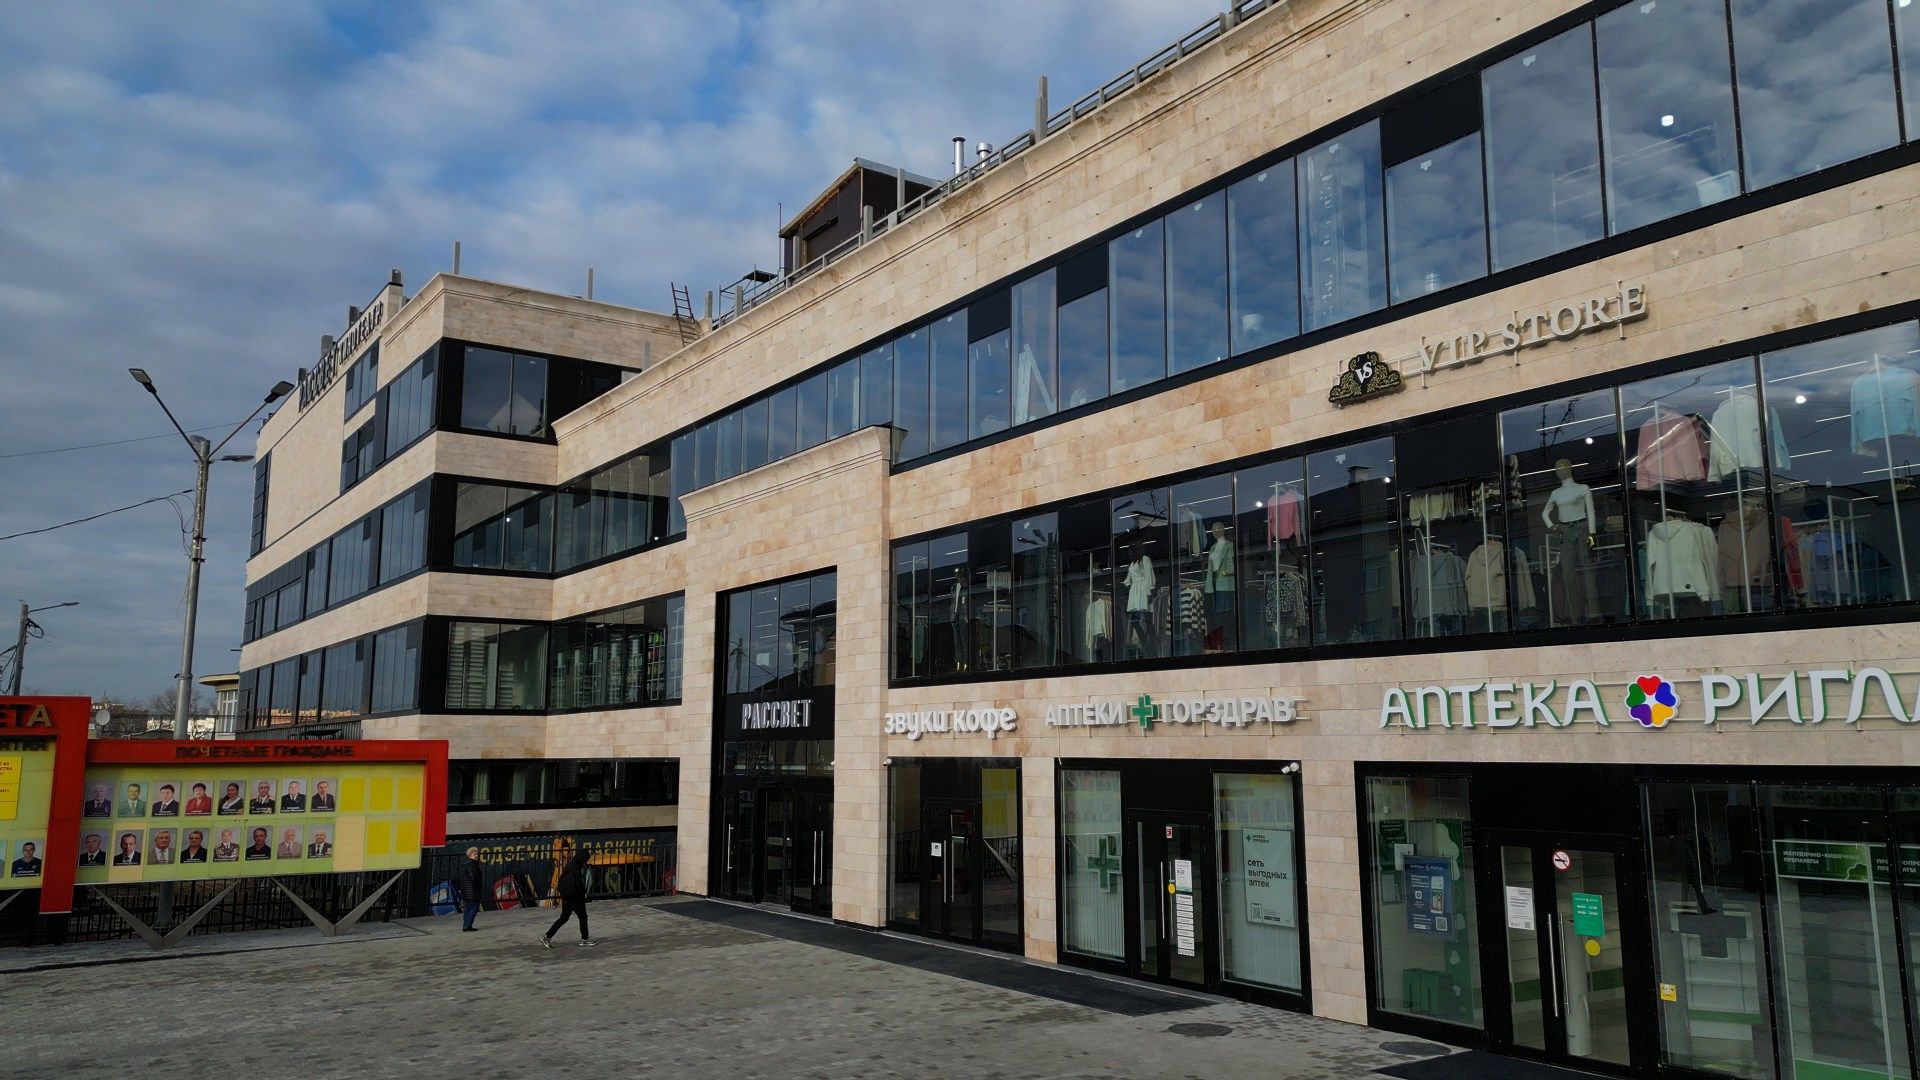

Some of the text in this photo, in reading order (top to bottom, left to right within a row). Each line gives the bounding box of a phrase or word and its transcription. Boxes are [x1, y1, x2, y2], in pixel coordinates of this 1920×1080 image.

[1417, 282, 1648, 372] VIP STORE
[1045, 698, 1297, 727] АПТЕКИ ГОРЗДРАВ
[1379, 667, 1920, 729] АПТЕКА РИГЛ
[741, 698, 814, 730] РАССВЕТ
[1247, 858, 1265, 868] сеть
[1248, 869, 1288, 880] выгодных
[1248, 879, 1270, 888] аптек
